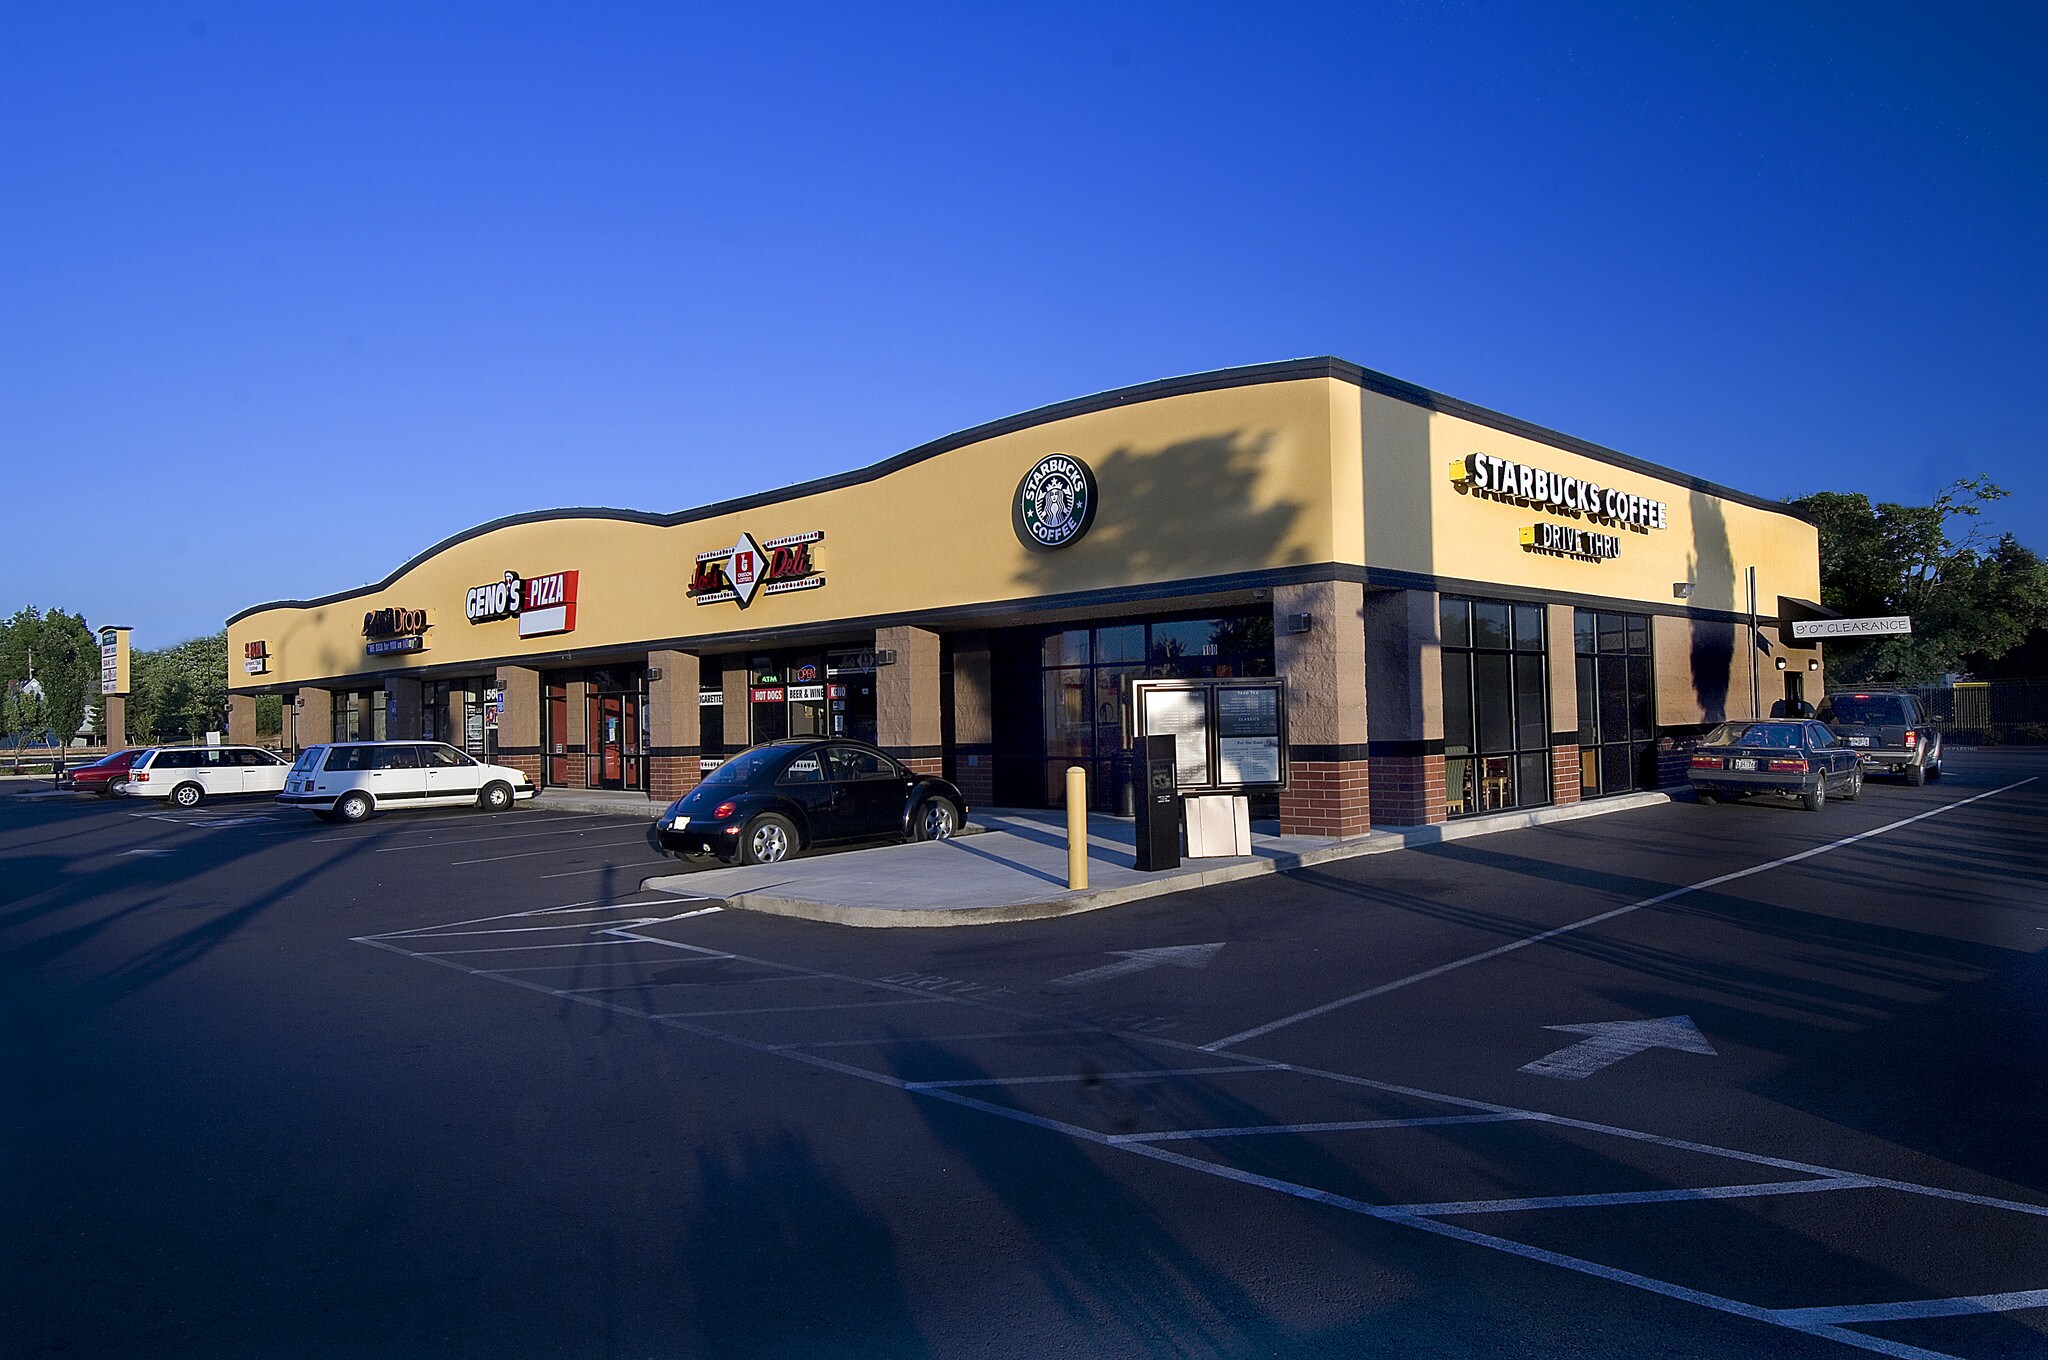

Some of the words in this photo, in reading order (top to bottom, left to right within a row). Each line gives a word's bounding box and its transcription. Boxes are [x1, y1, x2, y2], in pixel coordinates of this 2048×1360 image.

[1026, 459, 1084, 501] STARBUCKS
[1474, 452, 1600, 514] STARBUCKS
[1604, 488, 1668, 530] COFFEE
[1032, 516, 1077, 541] COFFEE
[1542, 522, 1583, 553] DRIVE
[1589, 532, 1622, 558] THRU
[771, 543, 805, 578] Deli
[466, 579, 521, 619] GENO'S
[530, 574, 564, 607] PIZZA
[1827, 620, 1907, 633] CLEARANCE
[1203, 644, 1217, 655] 100
[798, 668, 816, 679] OPEN
[755, 691, 766, 701] HOT
[768, 690, 782, 701] DOGS
[790, 689, 803, 699] BEER
[804, 689, 810, 698] &
[810, 688, 824, 698] WINE
[830, 686, 846, 697] KENO
